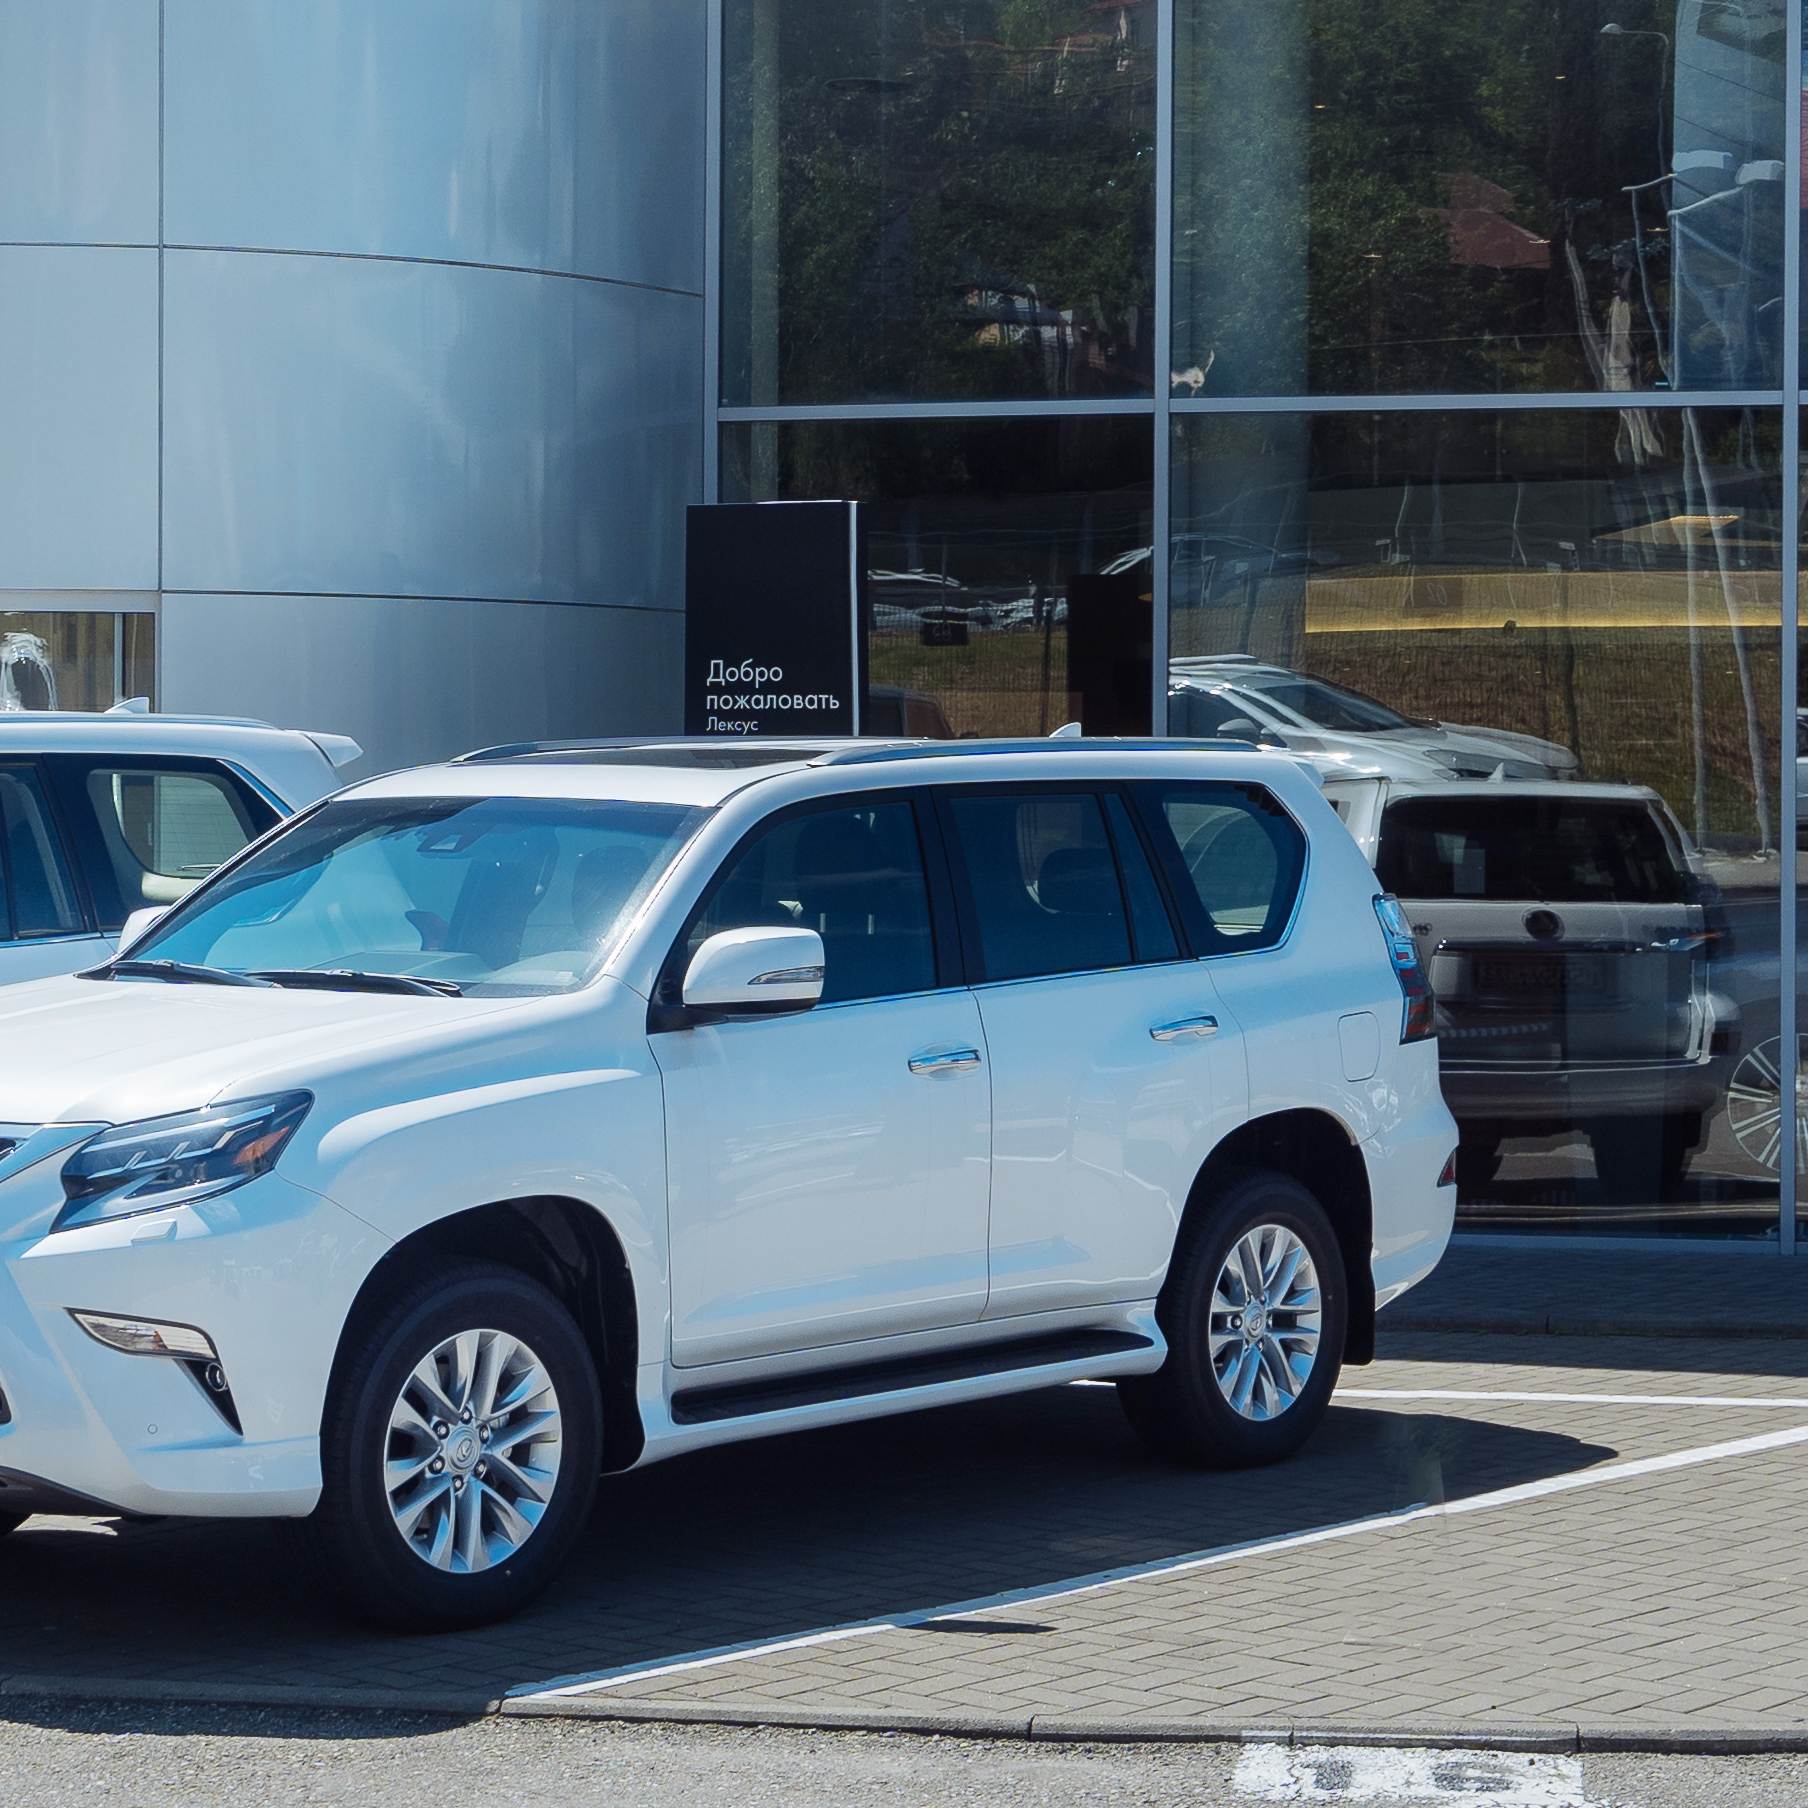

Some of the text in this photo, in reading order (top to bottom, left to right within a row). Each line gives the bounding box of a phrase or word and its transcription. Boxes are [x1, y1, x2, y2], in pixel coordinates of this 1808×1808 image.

[706, 658, 783, 688] Добро
[706, 692, 840, 710] пожаловать
[706, 716, 759, 734] Лексус
